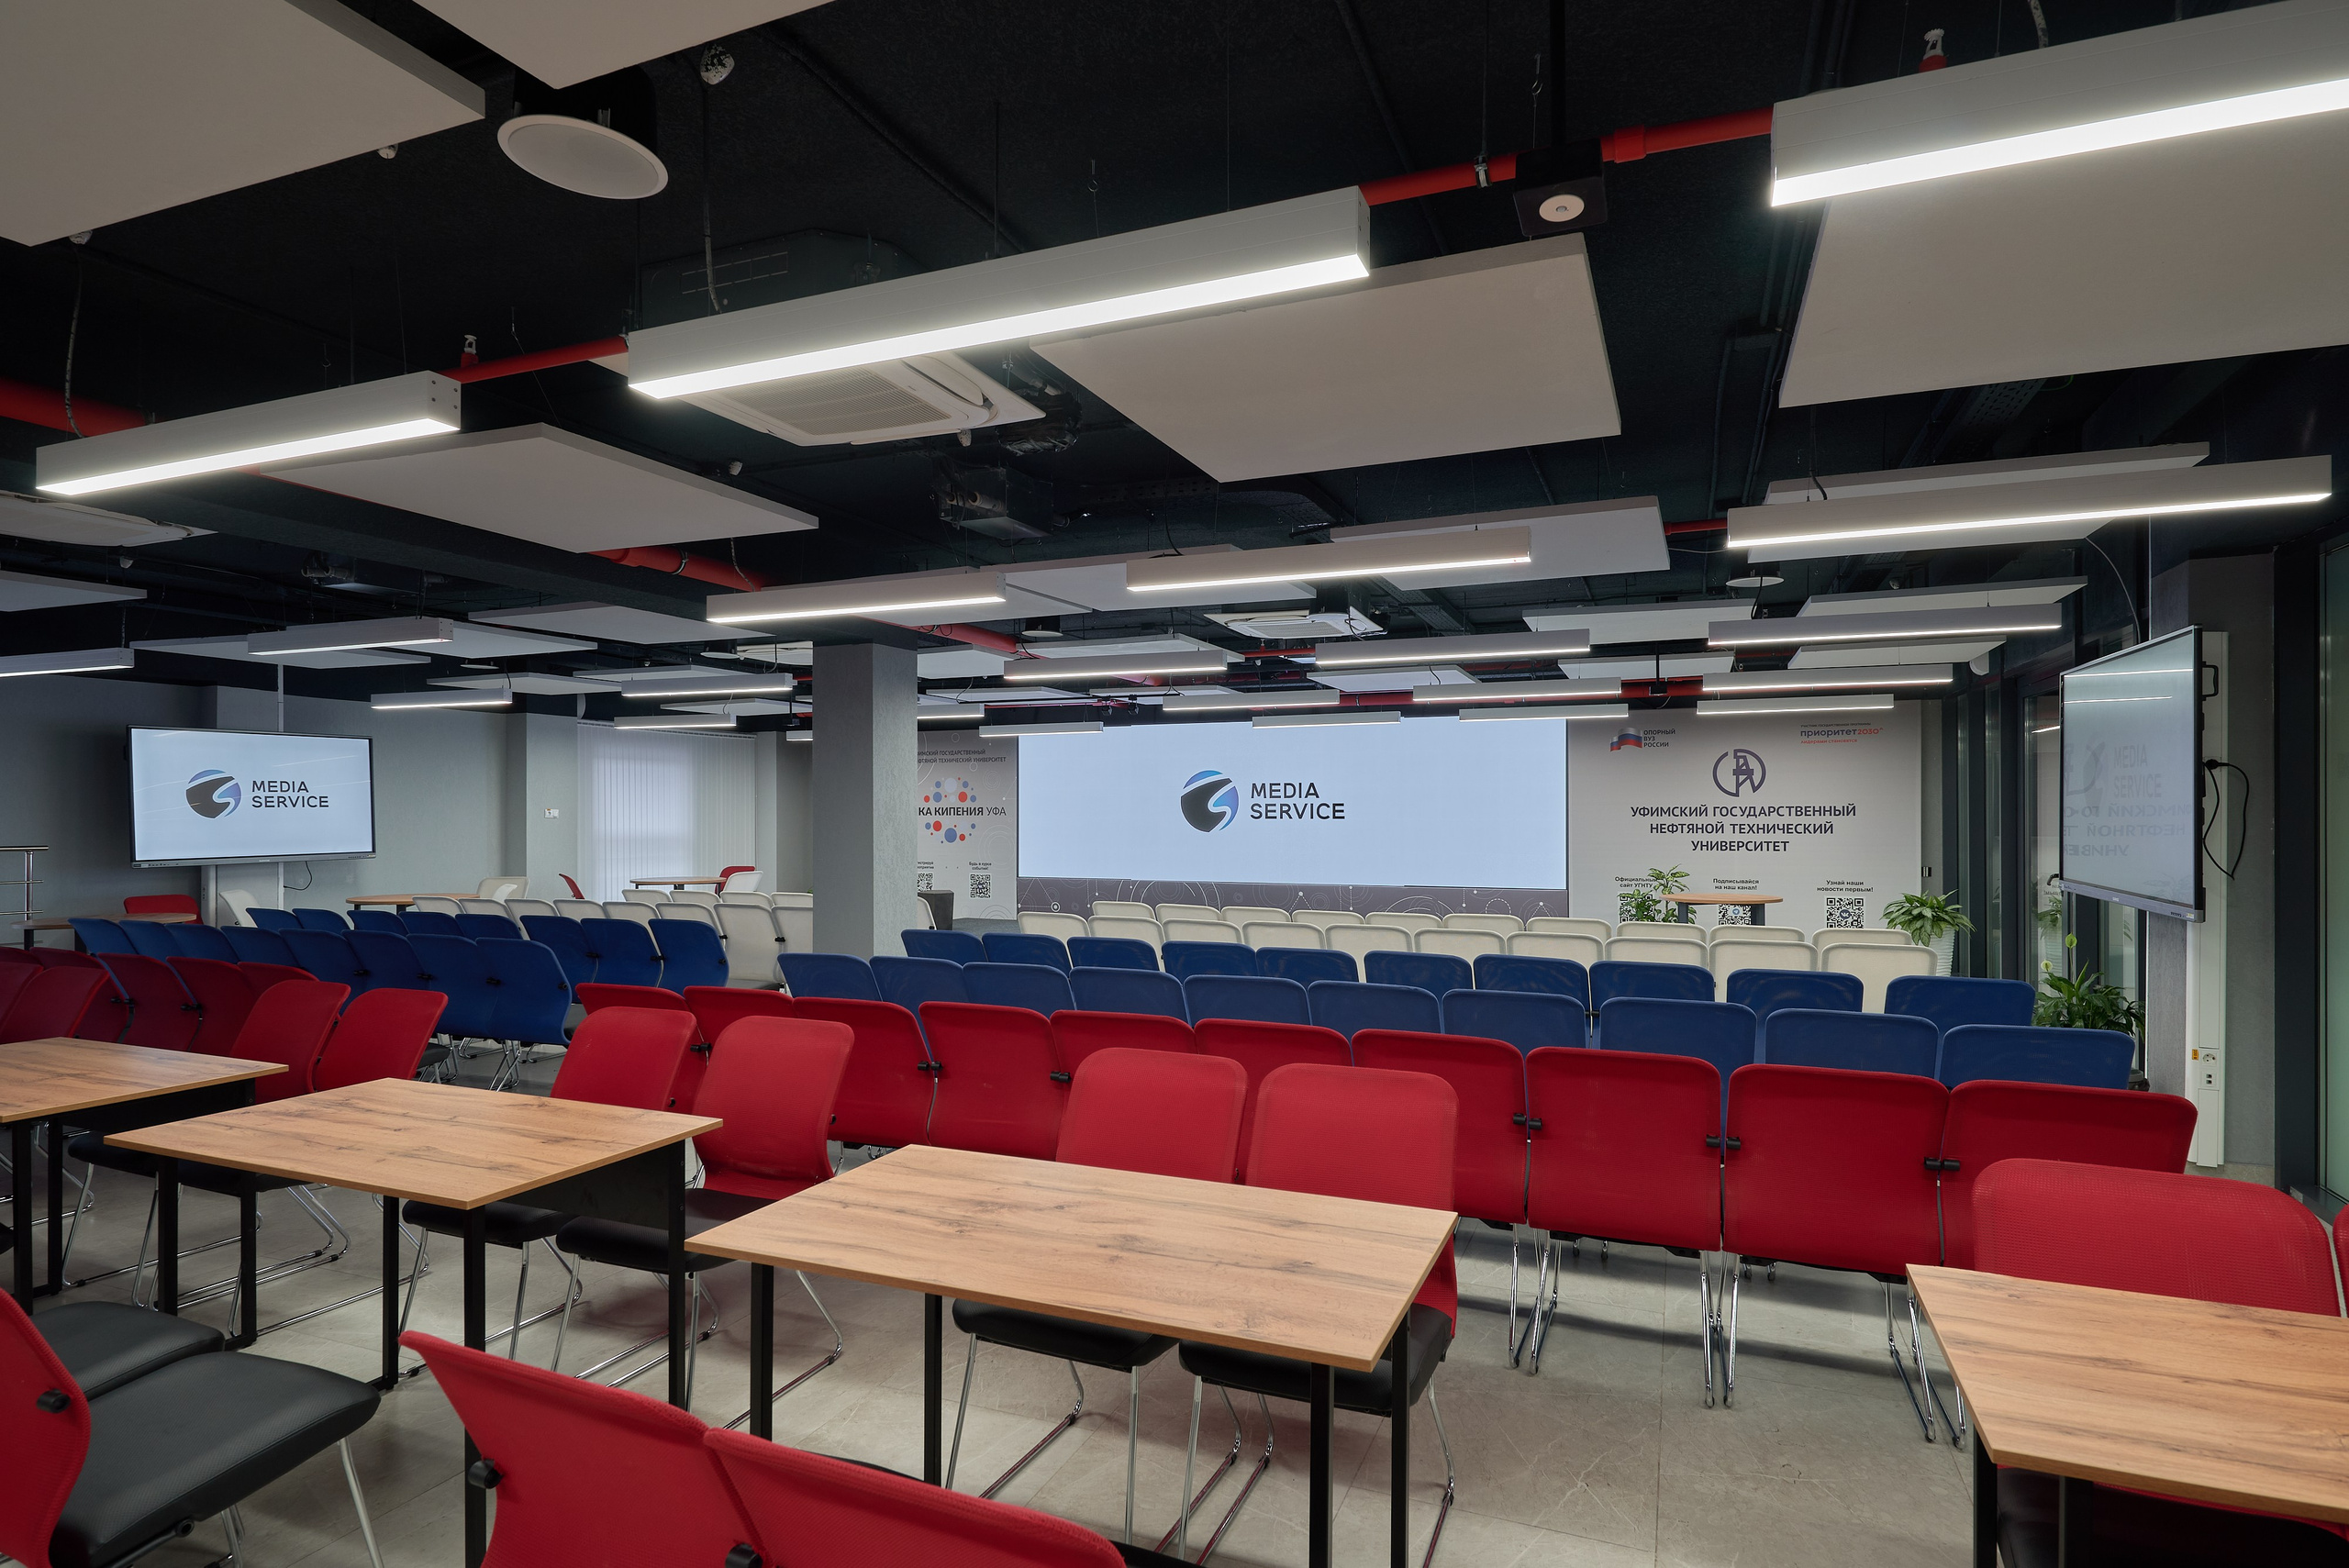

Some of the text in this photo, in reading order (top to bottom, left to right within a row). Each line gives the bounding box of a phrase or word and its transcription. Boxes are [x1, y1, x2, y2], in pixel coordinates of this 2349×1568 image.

[251, 780, 309, 793] MEDIA
[1251, 782, 1320, 799] MEDIA
[251, 795, 329, 808] SERVICE
[934, 806, 984, 816] КИПЕНИЯ
[986, 806, 1007, 816] УФА
[1250, 803, 1346, 819] SERVICE
[1630, 803, 1856, 818] УФИМСКИЙ ГОСУДАРСТВЕННЫЙ
[1650, 820, 1834, 835] НЕФТЯНОЙ ТЕХНИЧЕСКИЙ
[1690, 840, 1790, 851] УНИВЕРСИТЕТ
